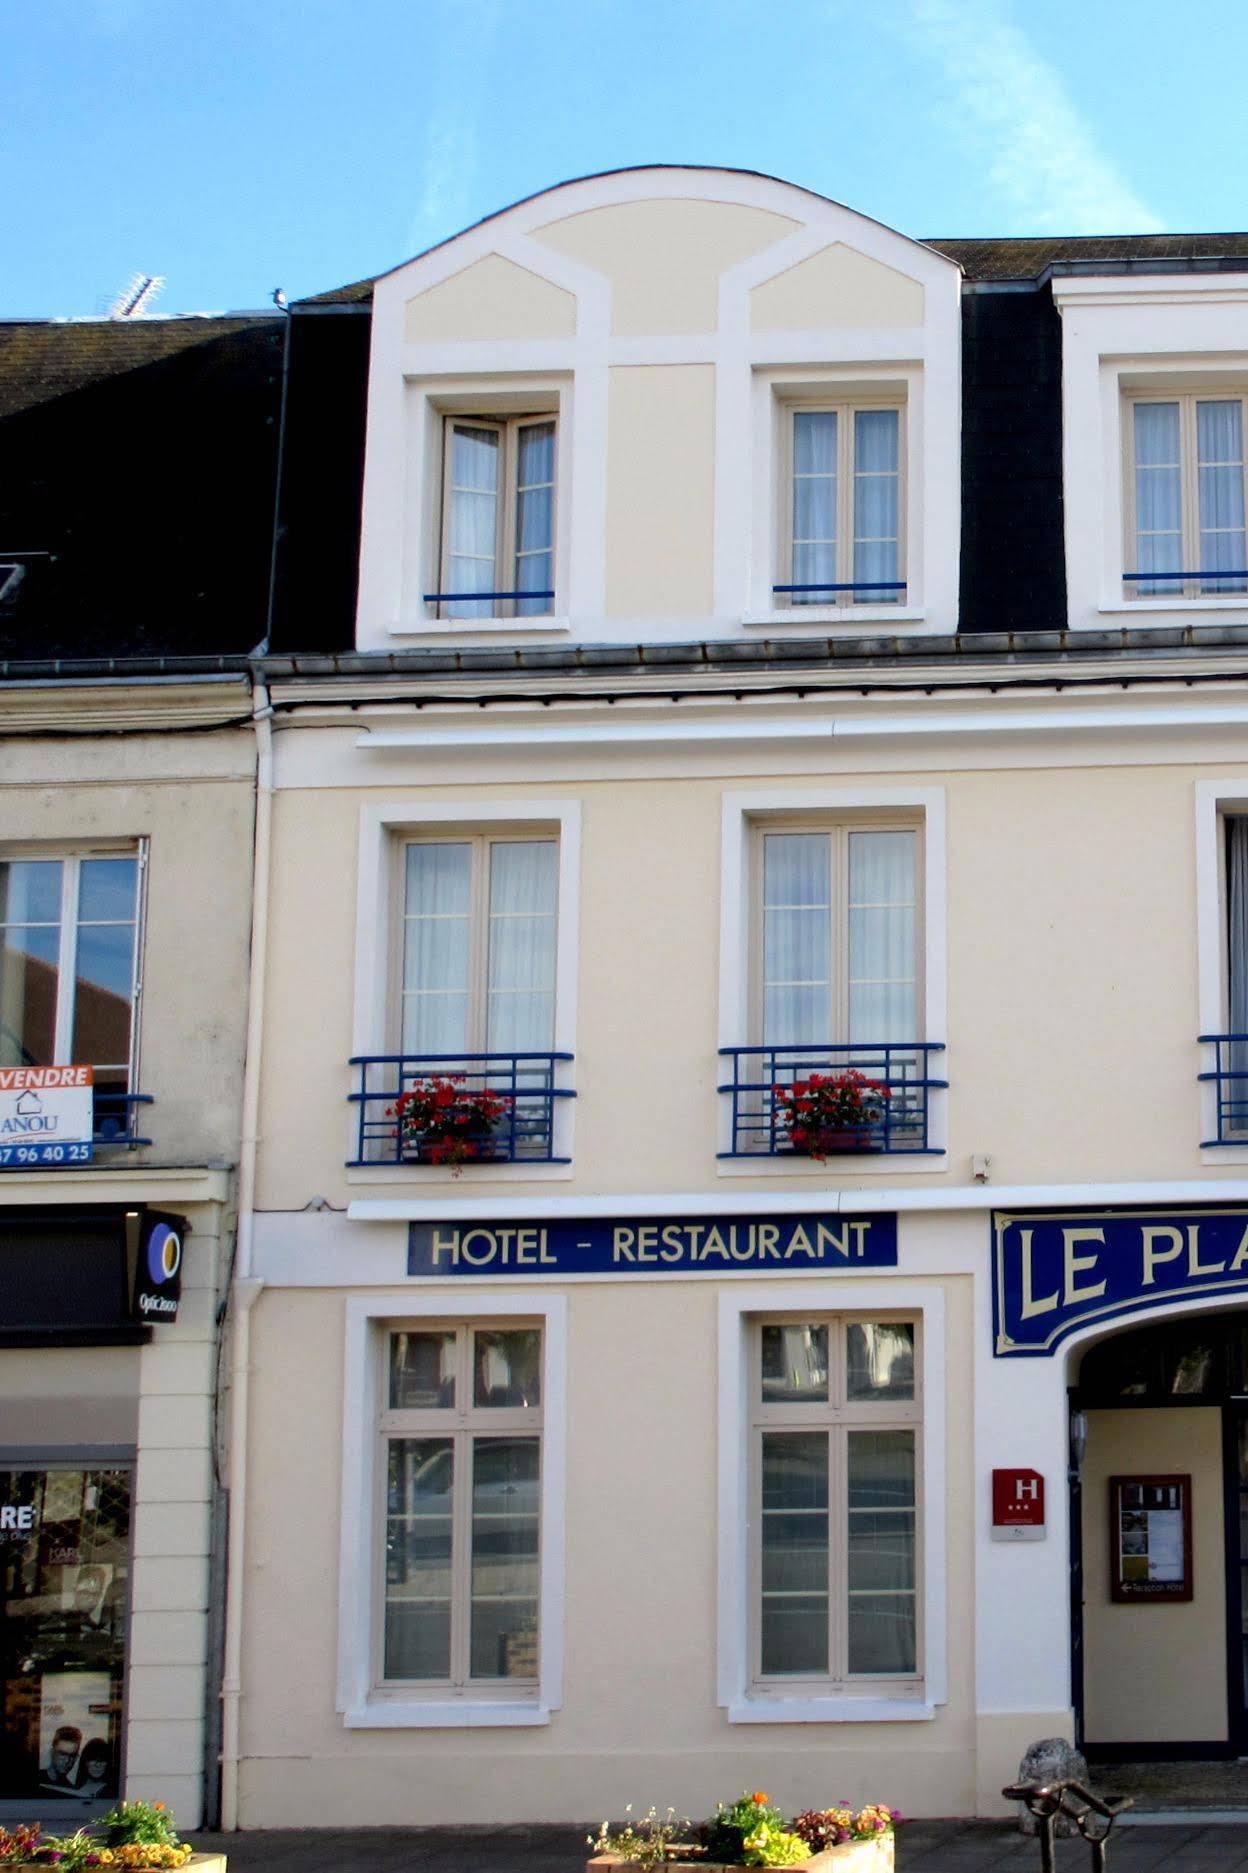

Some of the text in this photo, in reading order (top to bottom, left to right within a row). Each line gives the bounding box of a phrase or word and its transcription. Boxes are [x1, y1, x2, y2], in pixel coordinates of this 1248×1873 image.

[0, 1068, 88, 1088] VENDRE
[0, 1145, 89, 1163] 7 96 40 25
[432, 1229, 557, 1265] HOTEL
[613, 1222, 871, 1263] RESTAURANT
[1020, 1228, 1106, 1321] LE
[1015, 1480, 1039, 1499] H
